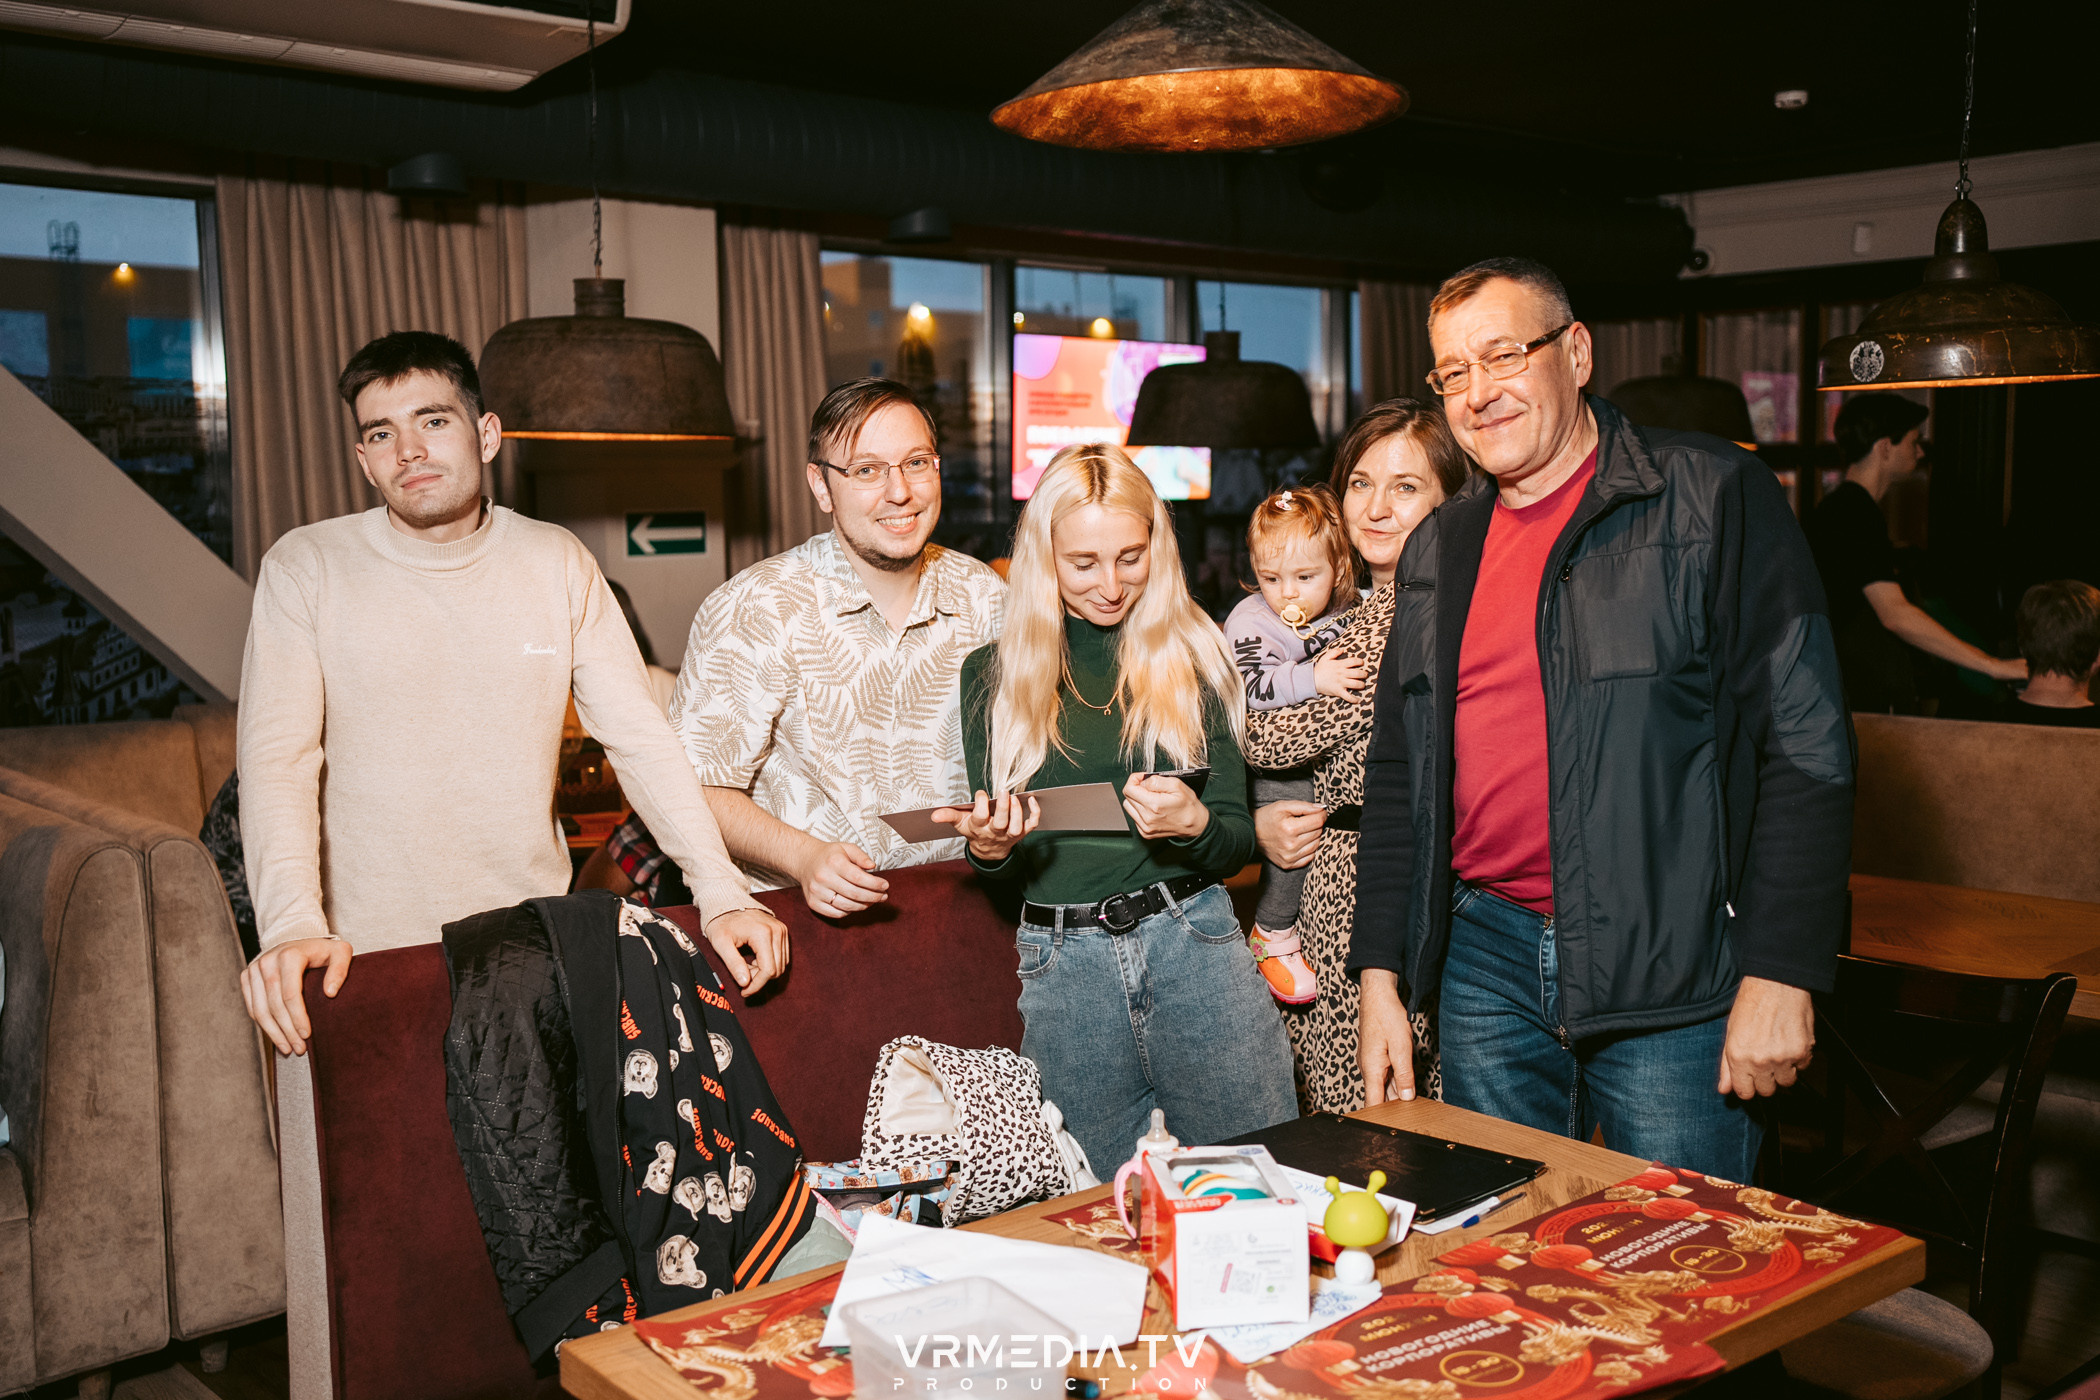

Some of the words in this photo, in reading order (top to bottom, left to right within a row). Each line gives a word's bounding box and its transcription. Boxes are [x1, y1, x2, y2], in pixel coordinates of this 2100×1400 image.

[751, 1108, 796, 1149] SUBCRUDE
[1599, 1220, 1691, 1262] НОВОГОДНИЕ
[1609, 1222, 1711, 1269] КОРПОРАТИВЫ
[1359, 1319, 1492, 1364] НОВОГОДНИЕ
[1365, 1323, 1511, 1373] КОРПОРАТИВЫ
